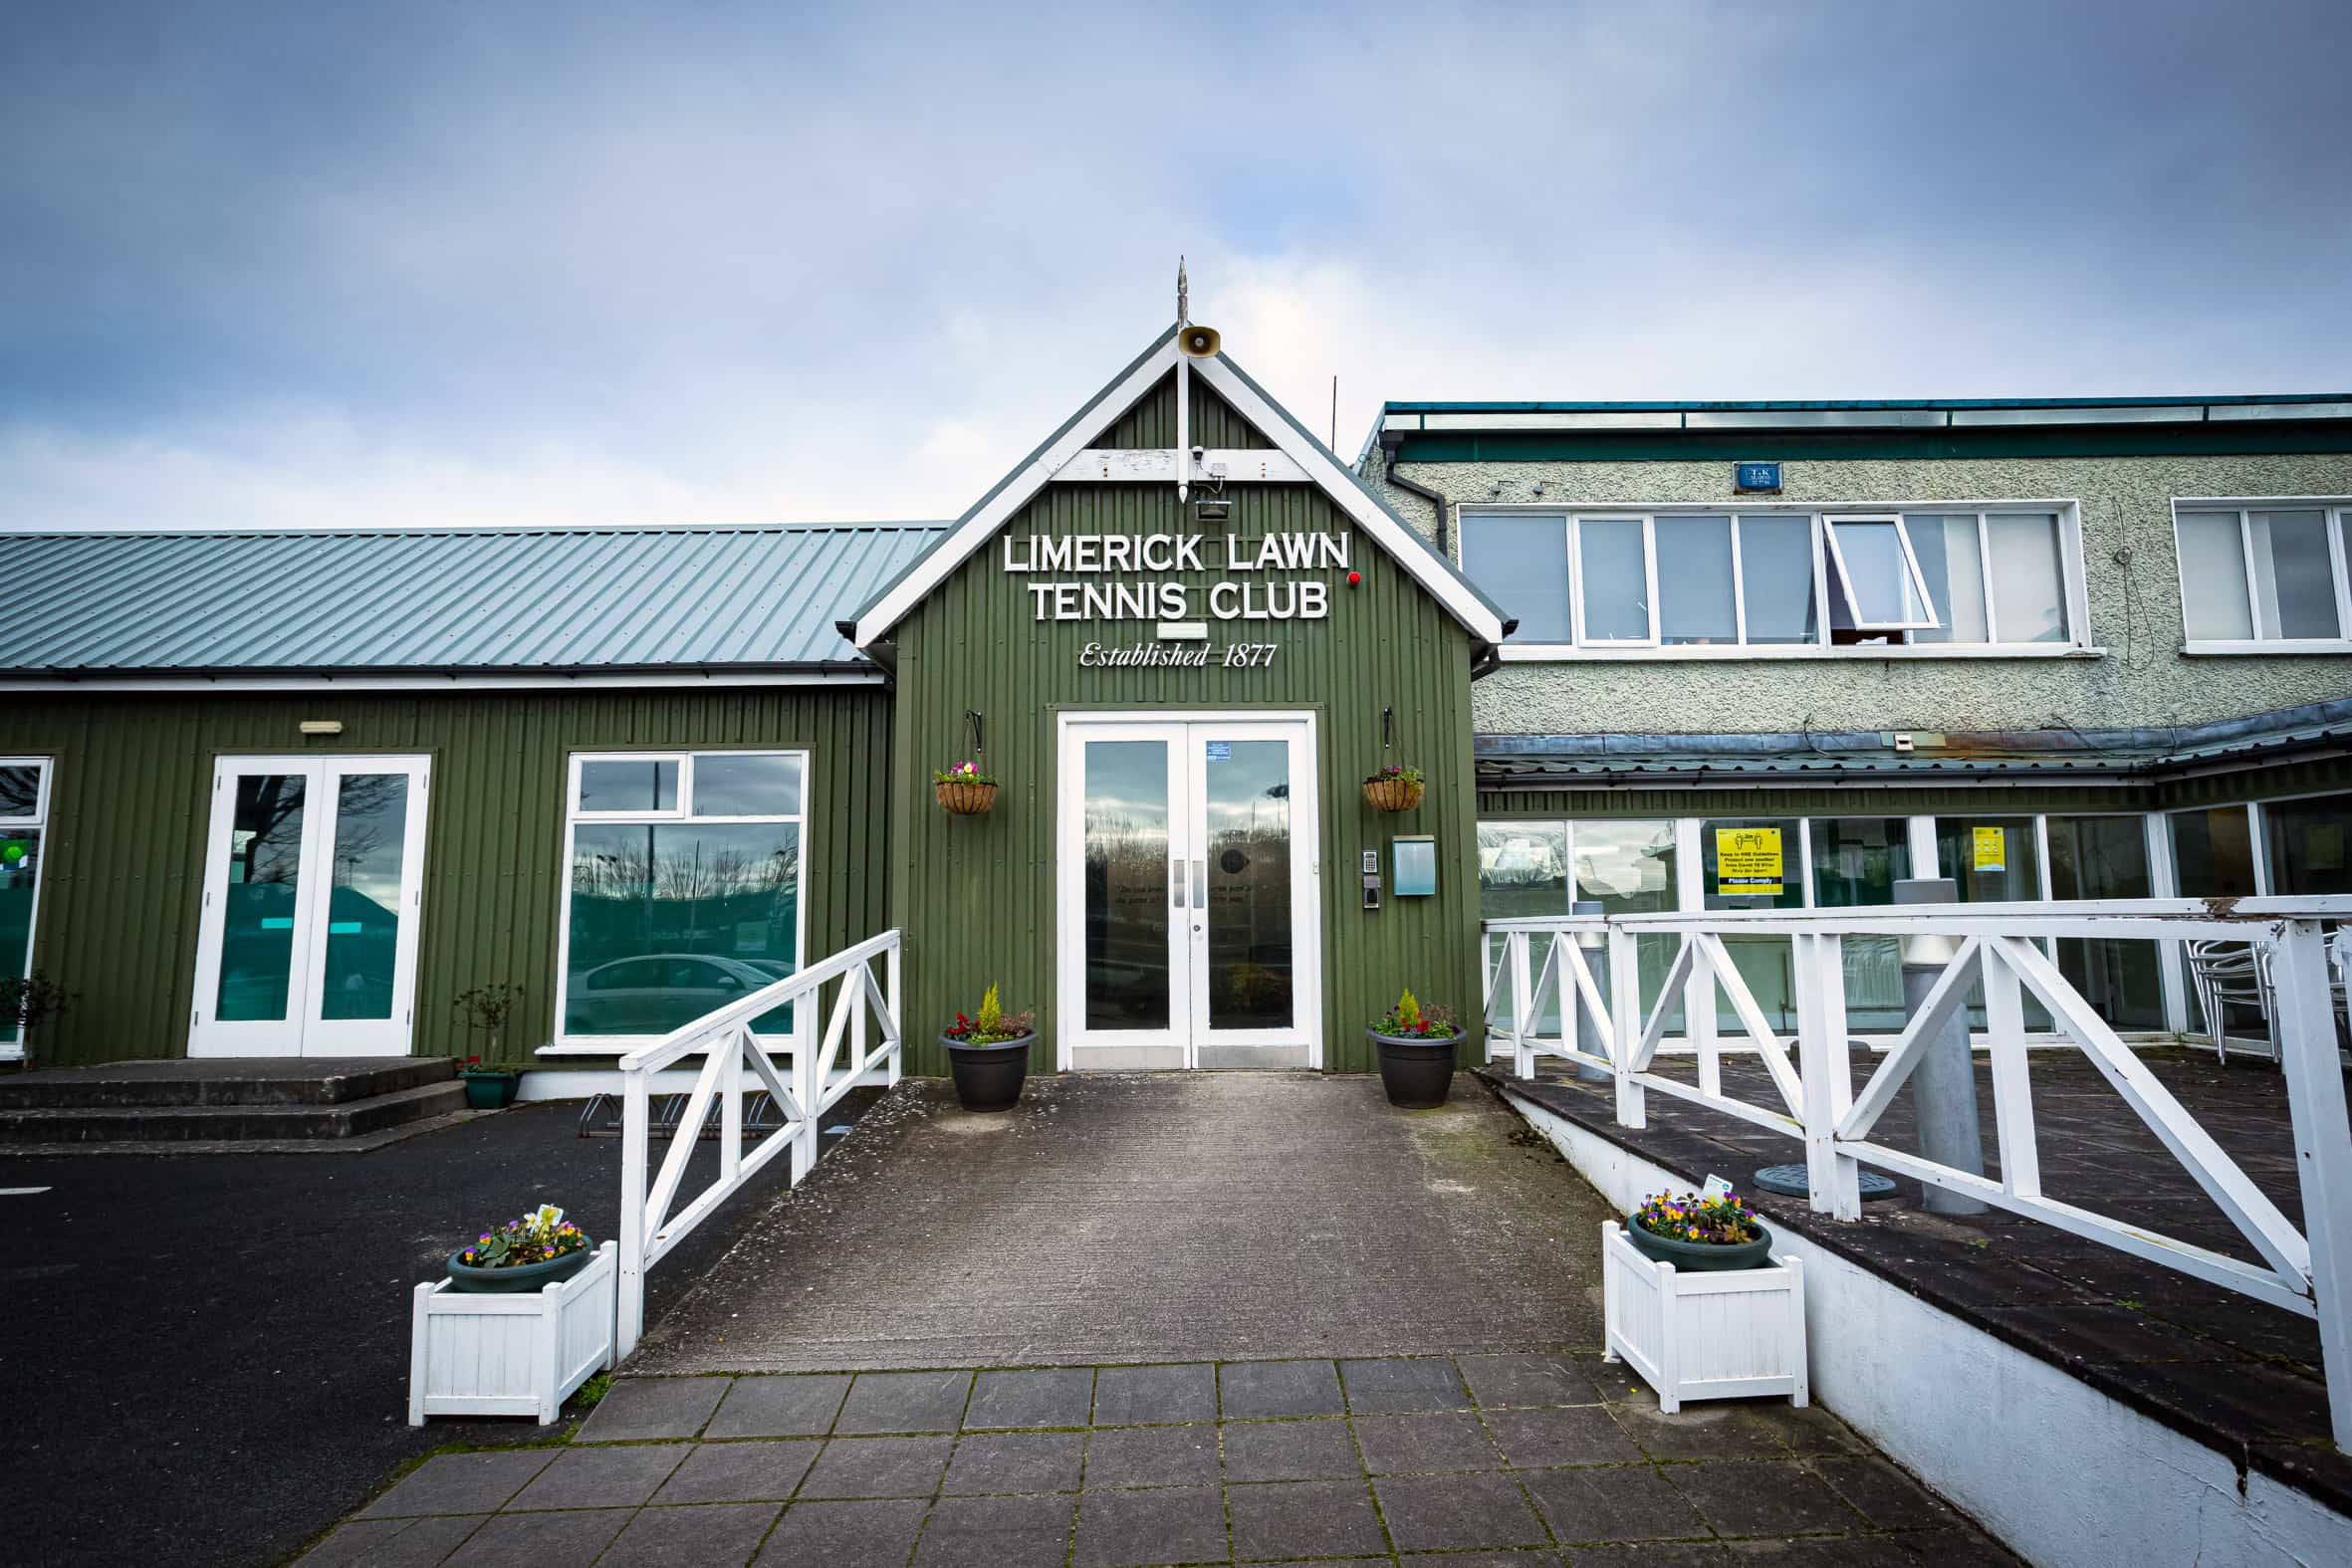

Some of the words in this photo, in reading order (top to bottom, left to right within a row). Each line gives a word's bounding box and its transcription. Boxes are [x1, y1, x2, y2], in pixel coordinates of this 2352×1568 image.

[1004, 534, 1205, 573] LIMERICK
[1227, 532, 1349, 571] LAWN
[1028, 581, 1187, 621] TENNIS
[1210, 581, 1329, 620] CLUB
[1078, 643, 1211, 667] Established
[1223, 644, 1278, 667] 1877
